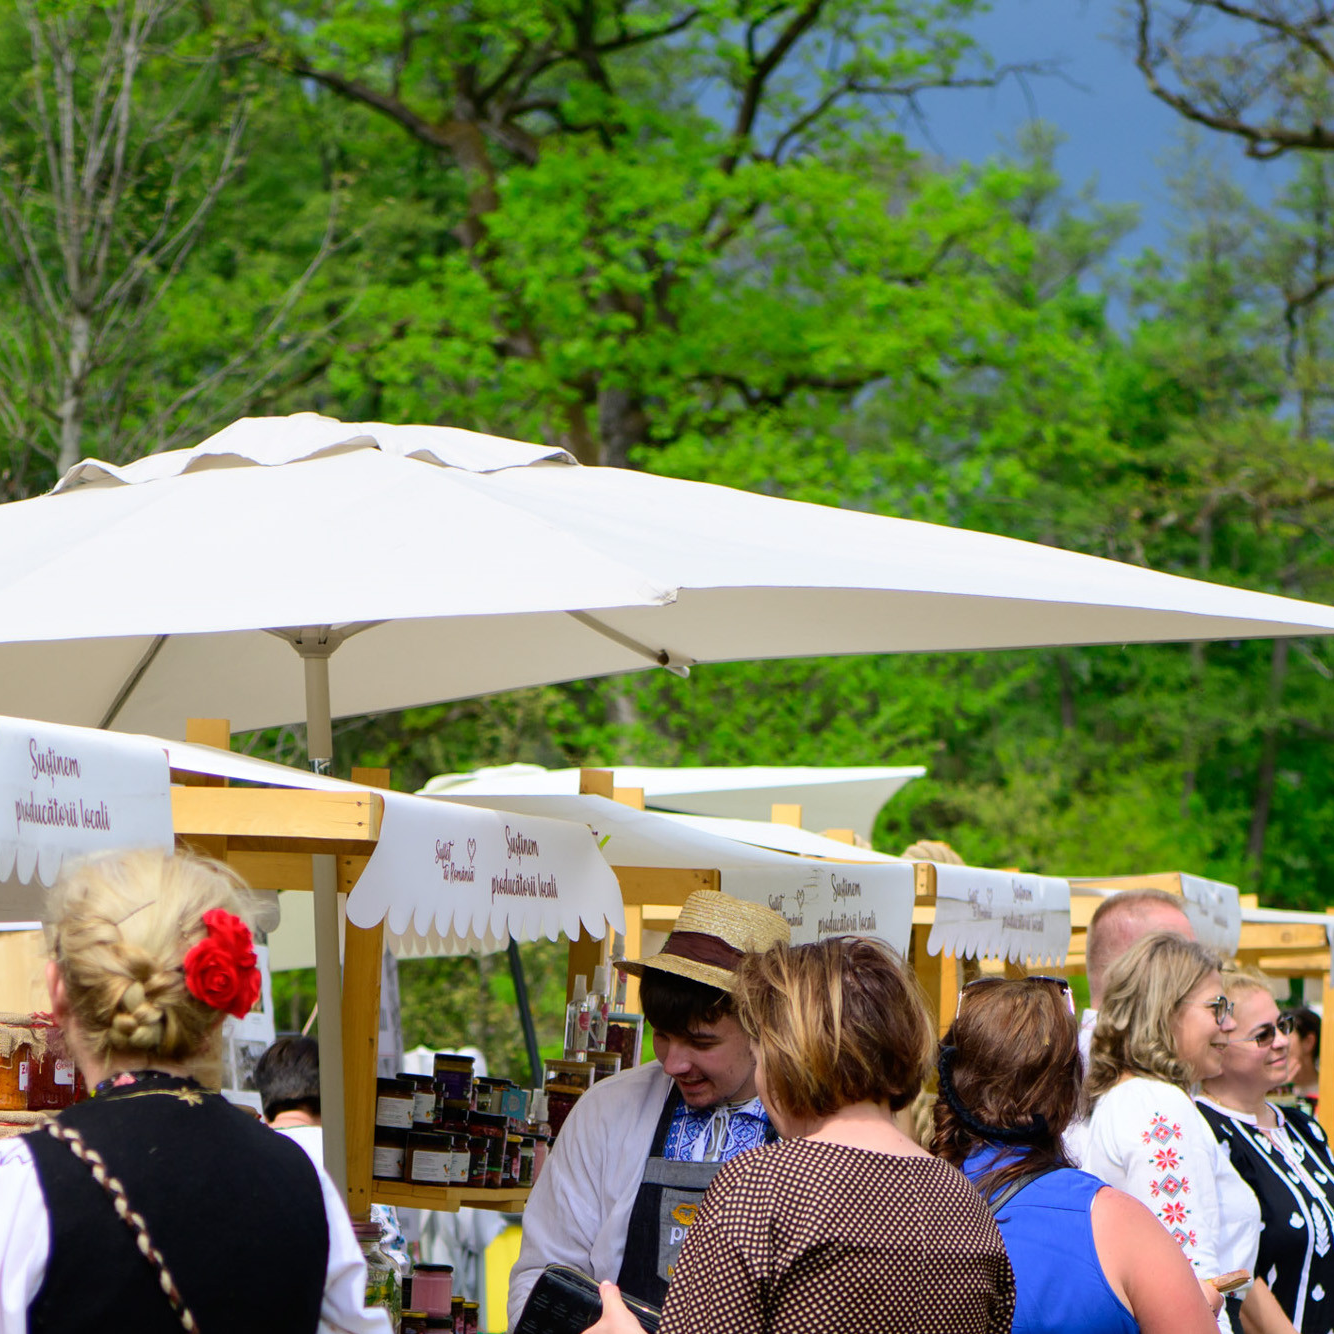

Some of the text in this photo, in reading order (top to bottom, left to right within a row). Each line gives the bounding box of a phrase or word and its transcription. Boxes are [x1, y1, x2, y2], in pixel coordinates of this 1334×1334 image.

[29, 738, 81, 788] Susținem
[15, 791, 111, 834] producătorii locali
[505, 825, 539, 865] Susținem
[491, 868, 558, 905] producătorii locali
